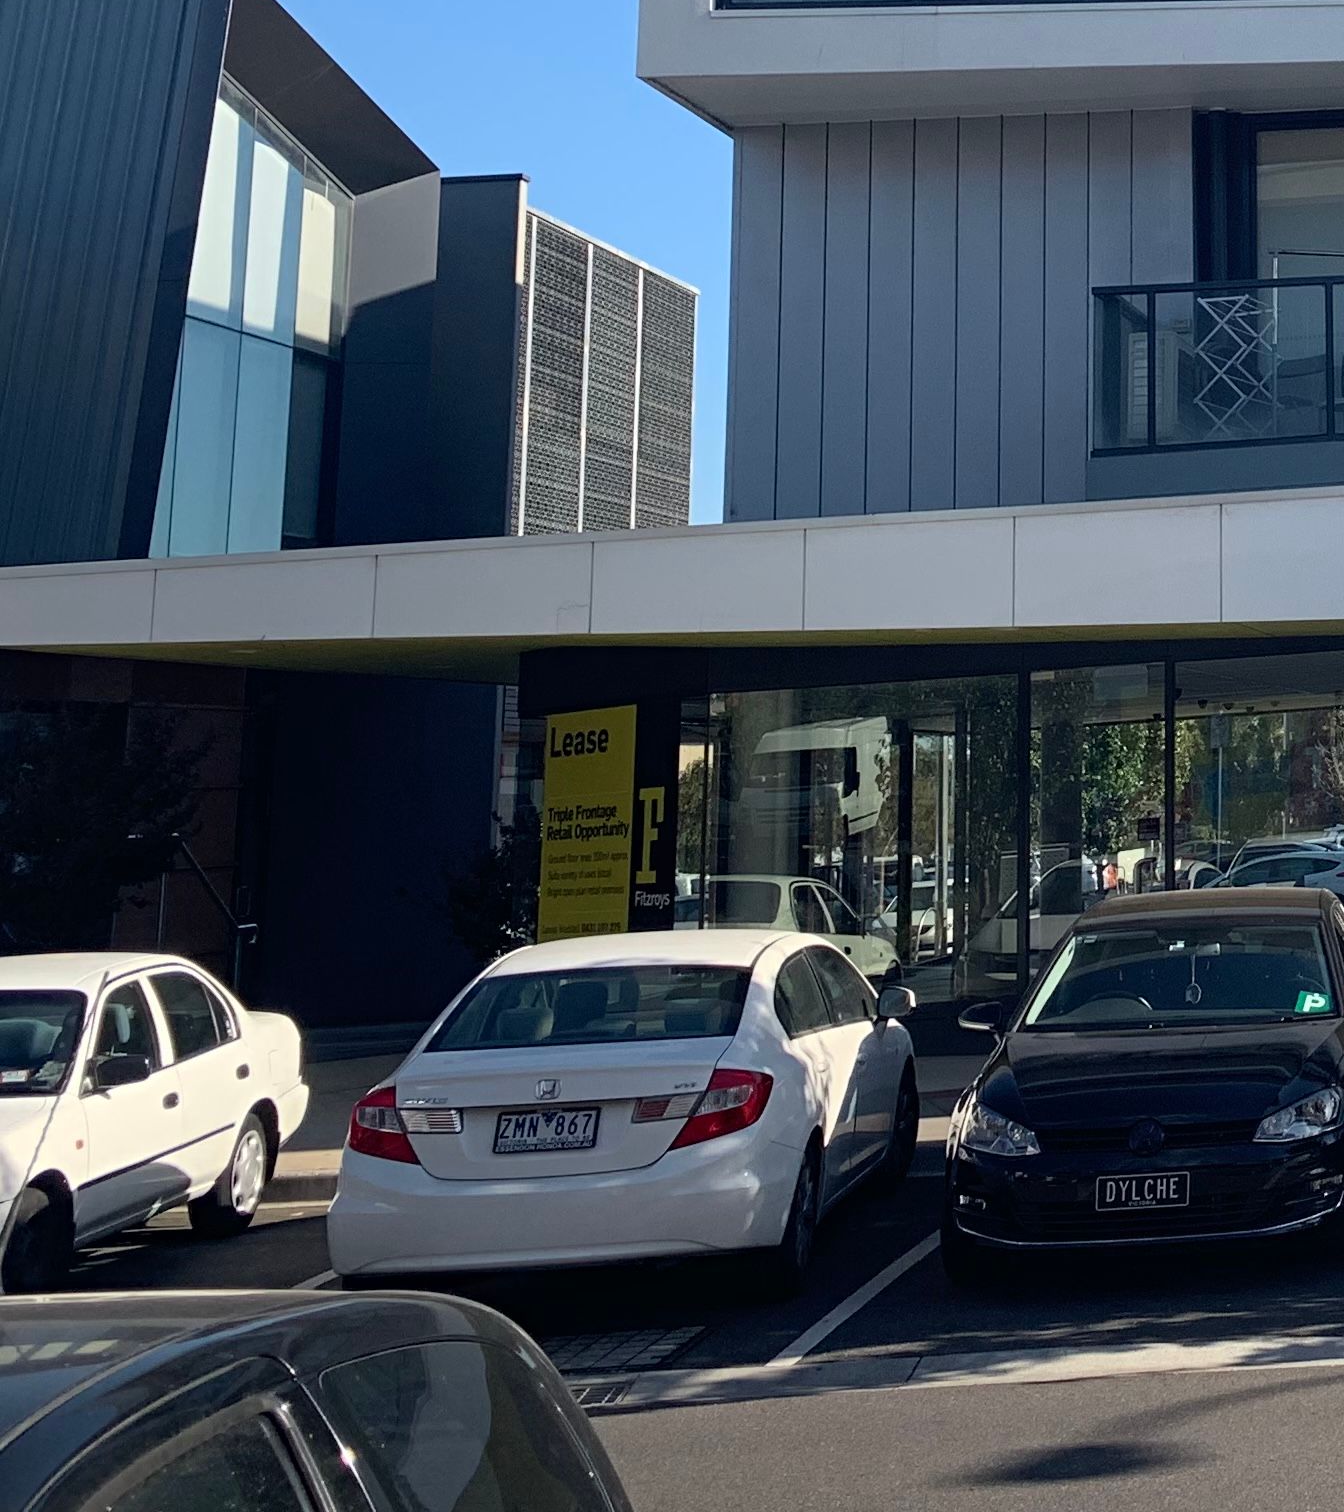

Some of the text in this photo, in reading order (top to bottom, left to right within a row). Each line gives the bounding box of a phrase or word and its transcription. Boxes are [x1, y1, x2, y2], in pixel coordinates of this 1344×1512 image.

[550, 727, 609, 758] Lease
[548, 804, 617, 824] Triple Frontage
[547, 820, 630, 841] Retail Opportunity
[636, 787, 665, 884] F
[635, 890, 670, 909] Fitzroys
[1302, 994, 1326, 1012] P
[499, 1113, 593, 1140] ZMN 867
[1105, 1177, 1180, 1203] DYLCHE
